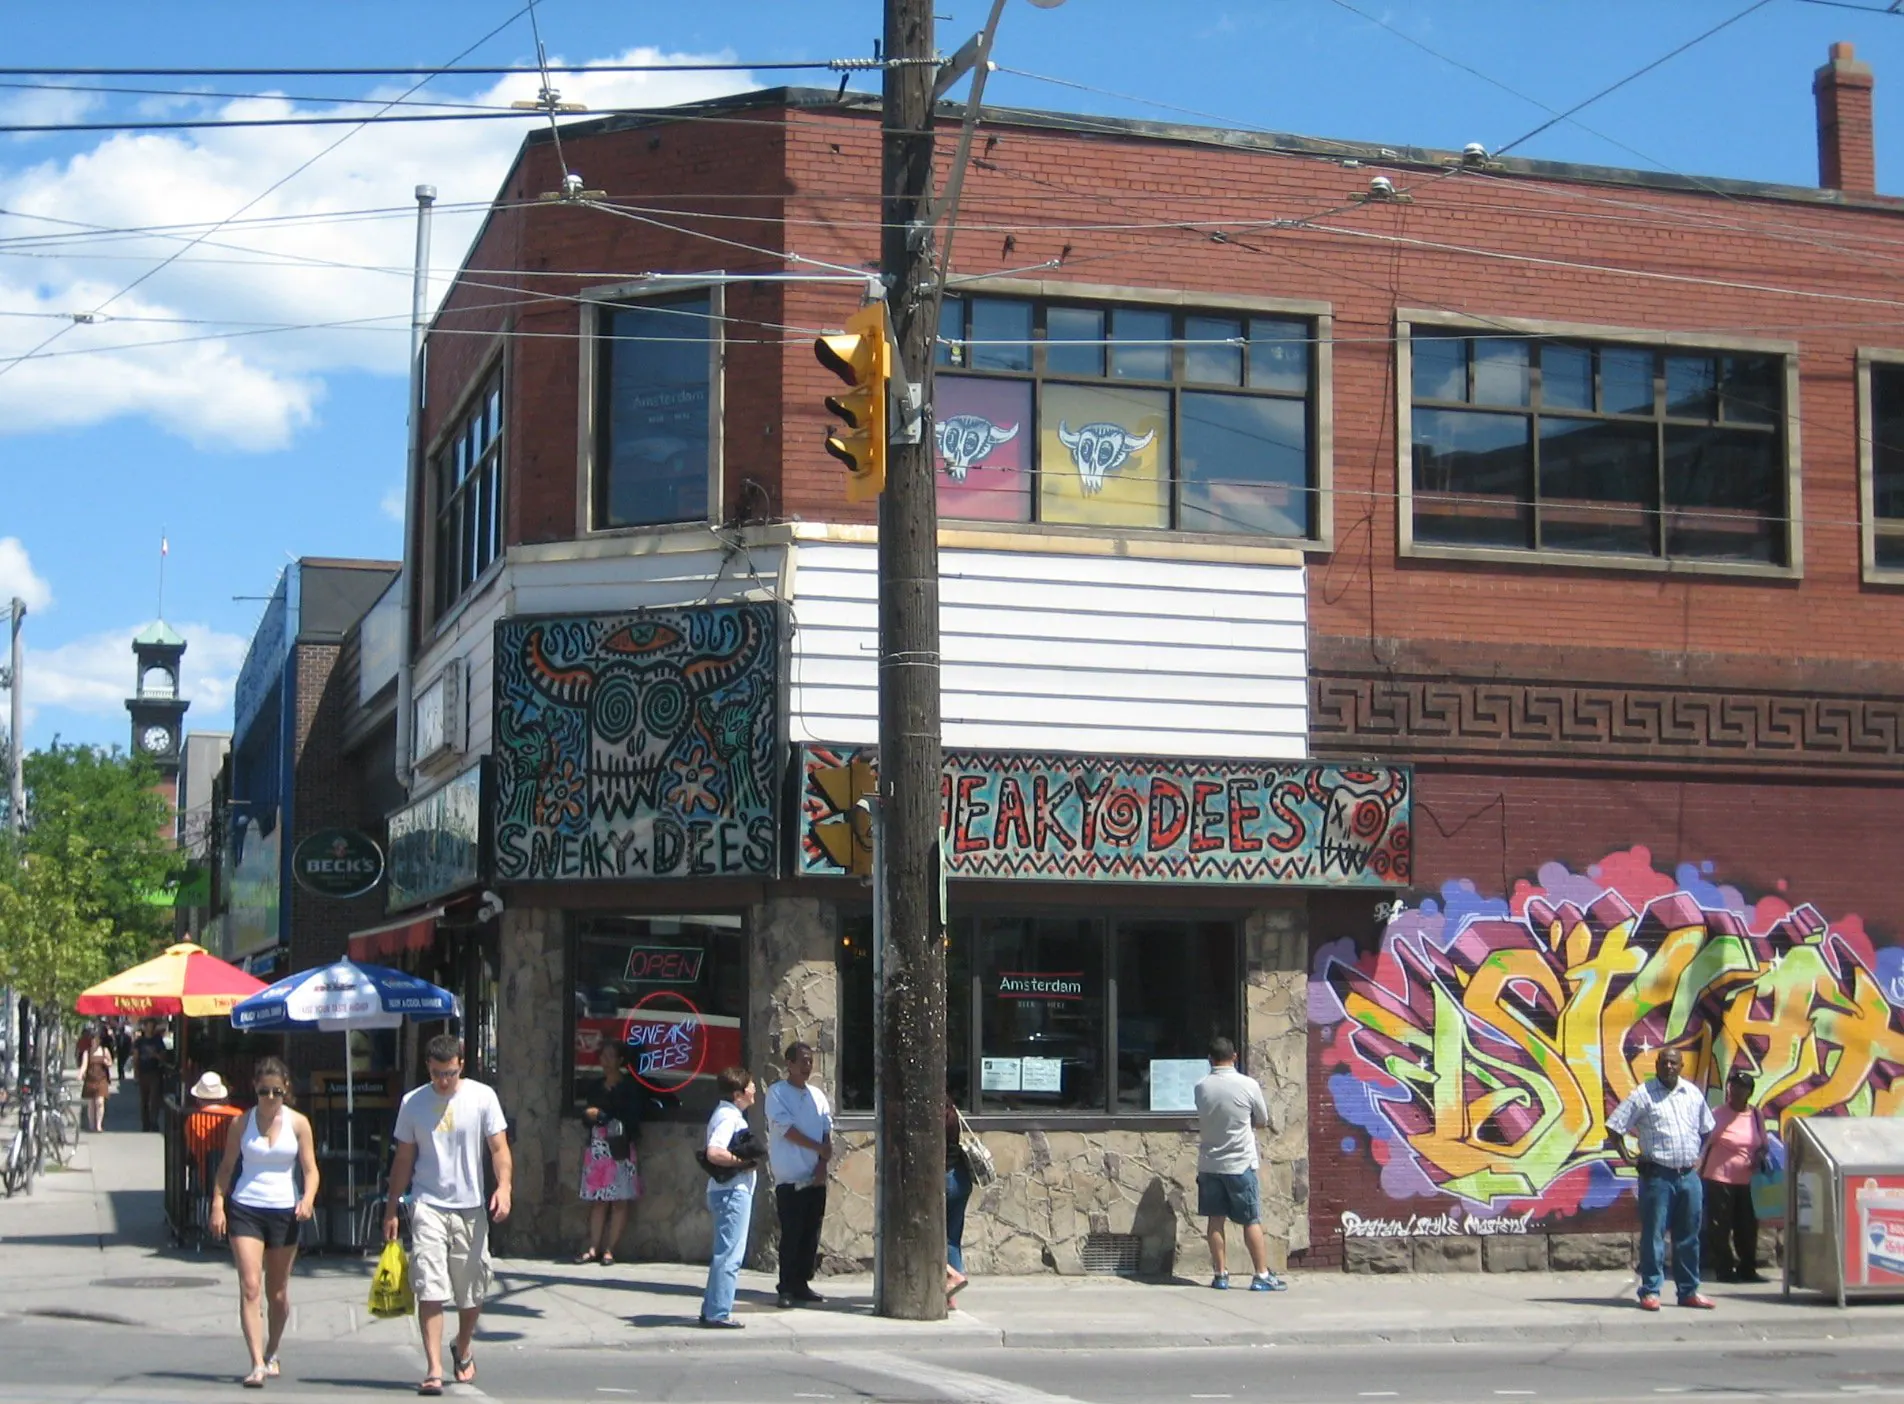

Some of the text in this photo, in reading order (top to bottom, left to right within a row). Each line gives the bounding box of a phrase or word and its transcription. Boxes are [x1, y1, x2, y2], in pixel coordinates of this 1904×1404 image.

[632, 389, 704, 407] Amsterdam
[940, 772, 1306, 855] EAKY DEE'S
[497, 812, 775, 878] SNEAKY DEE'S
[306, 857, 374, 873] BECK'S
[630, 951, 700, 979] OPEN
[999, 976, 1081, 993] Amsterdam
[328, 1082, 384, 1093] Amserdam
